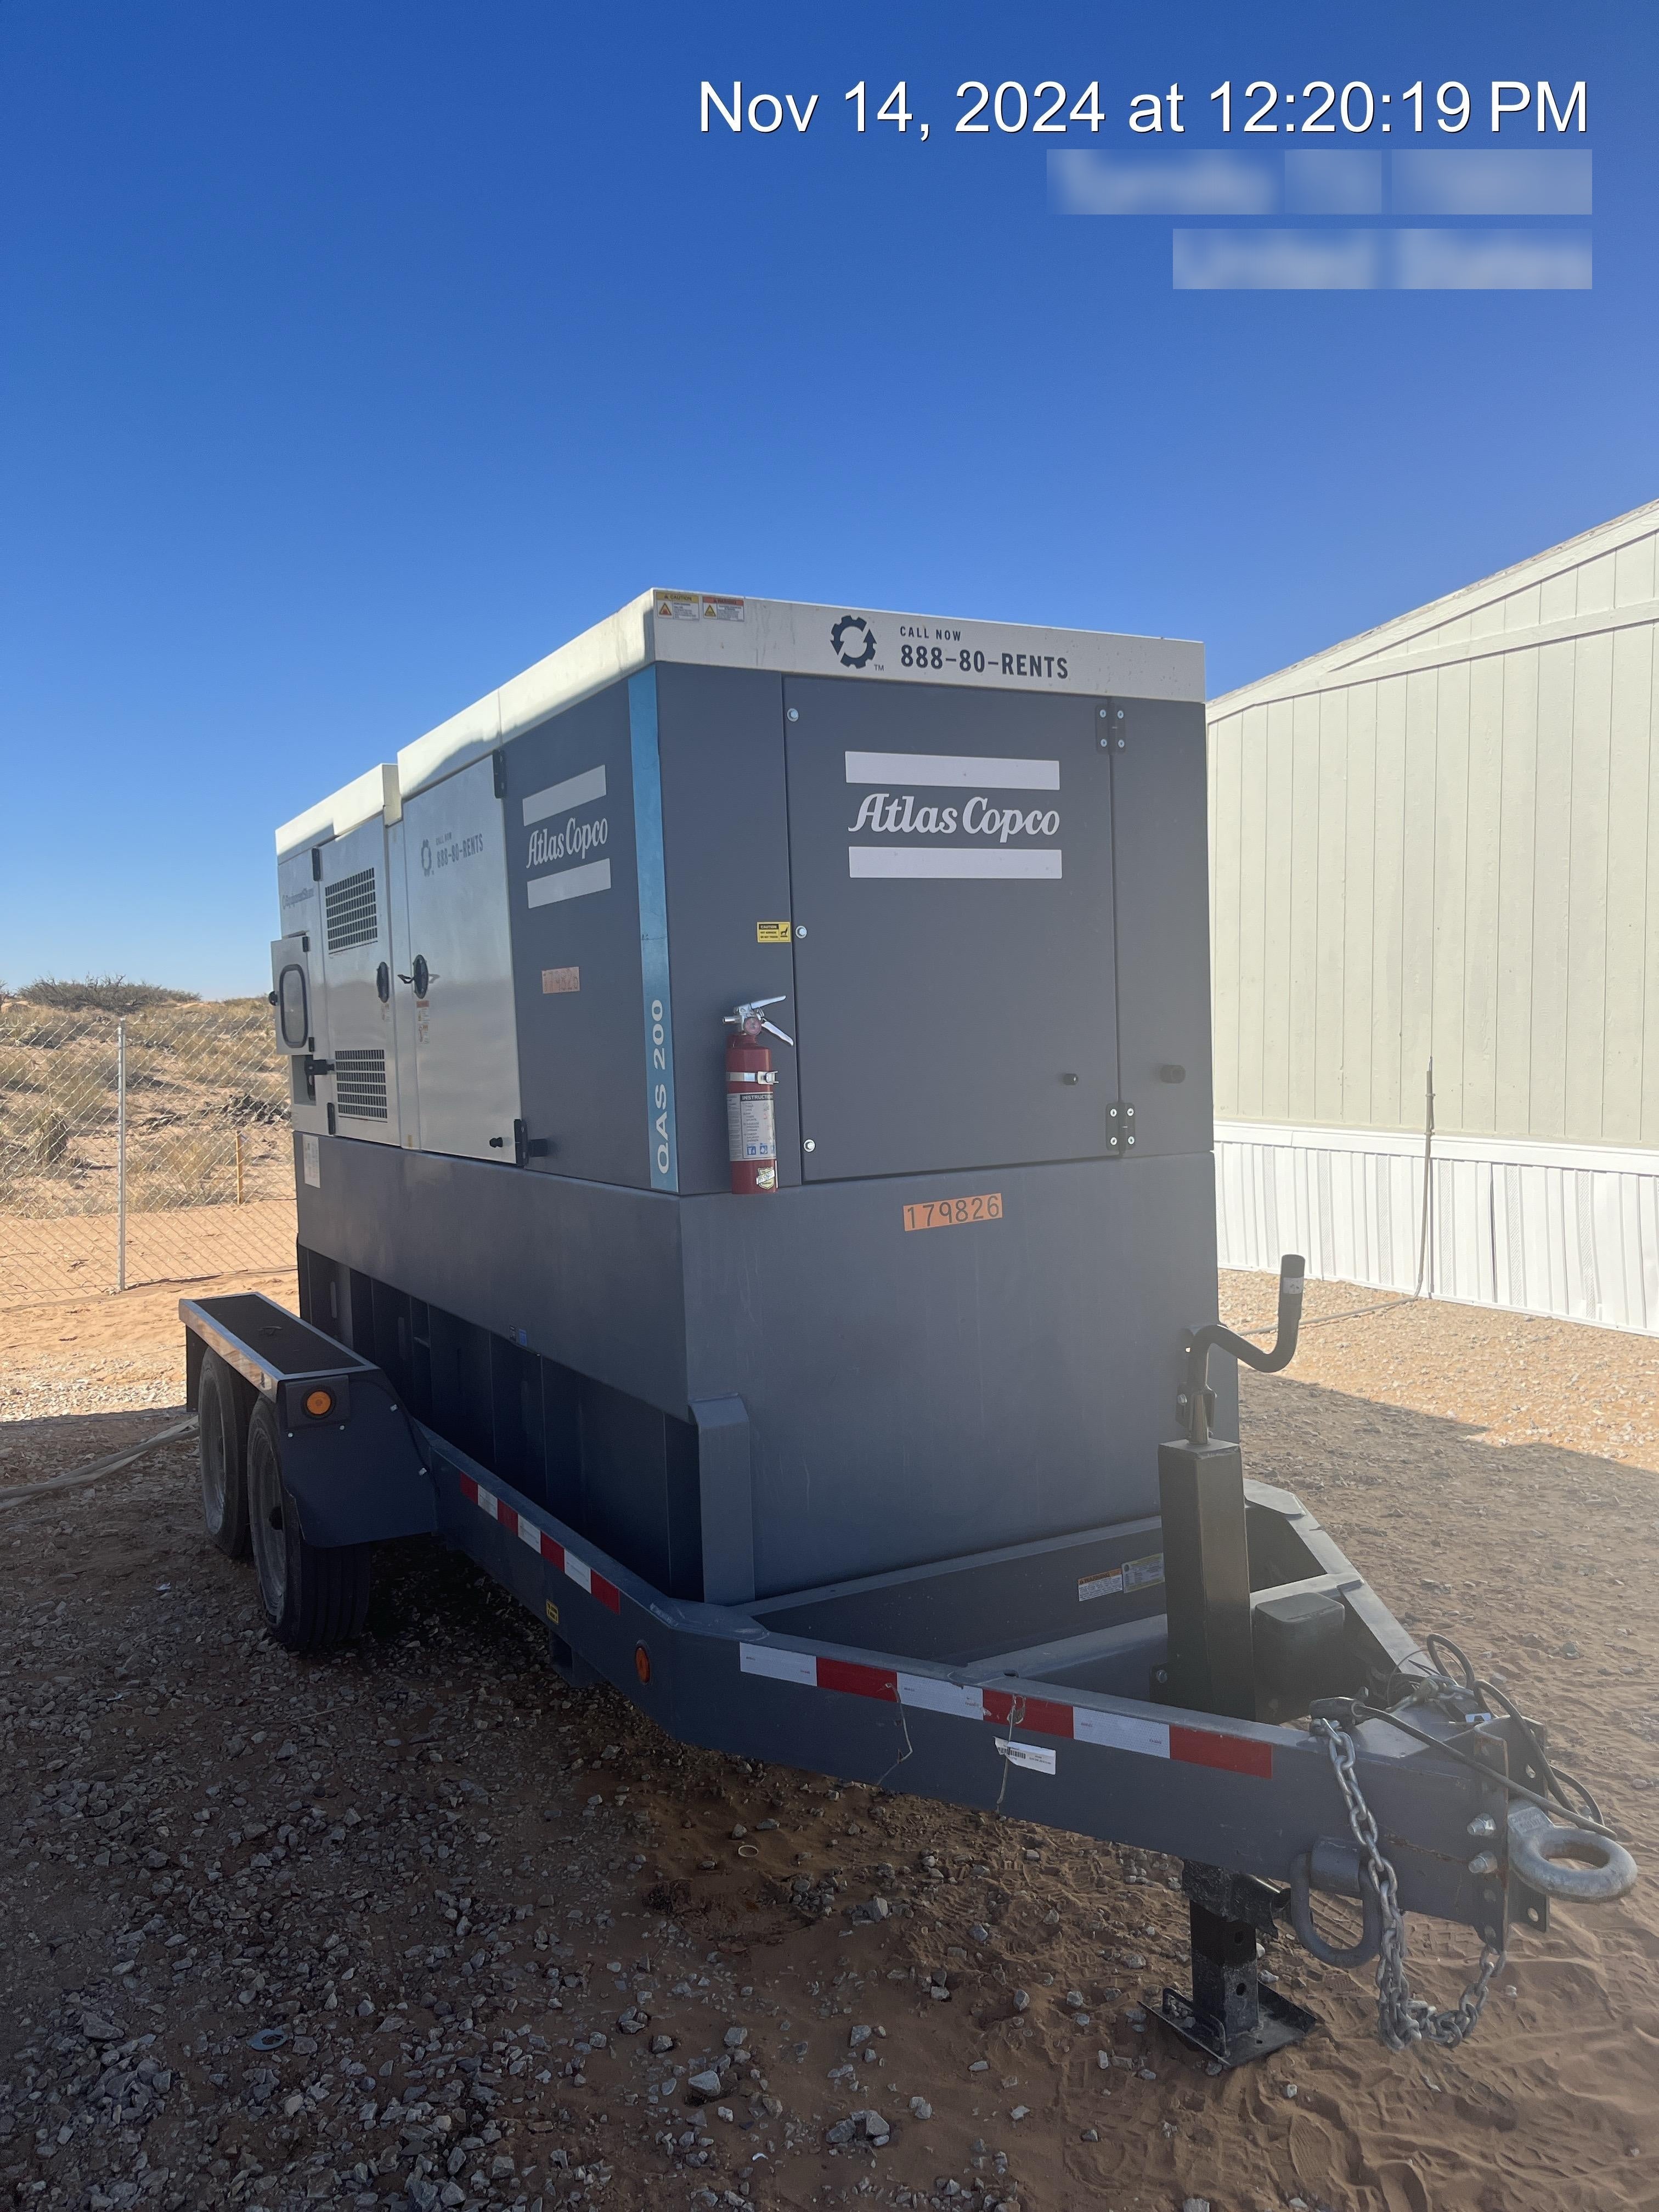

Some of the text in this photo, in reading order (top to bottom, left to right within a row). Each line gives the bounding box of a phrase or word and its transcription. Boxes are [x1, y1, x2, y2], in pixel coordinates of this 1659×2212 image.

[900, 626, 961, 641] CALL NOW
[900, 644, 1068, 679] 888-80-RENTS
[848, 793, 1060, 843] Atlas Copco
[437, 833, 483, 868] 888-80-RENTS
[526, 817, 608, 869] Atlas Copco
[651, 999, 669, 1175] QAS 200
[907, 1195, 1000, 1229] 179826
